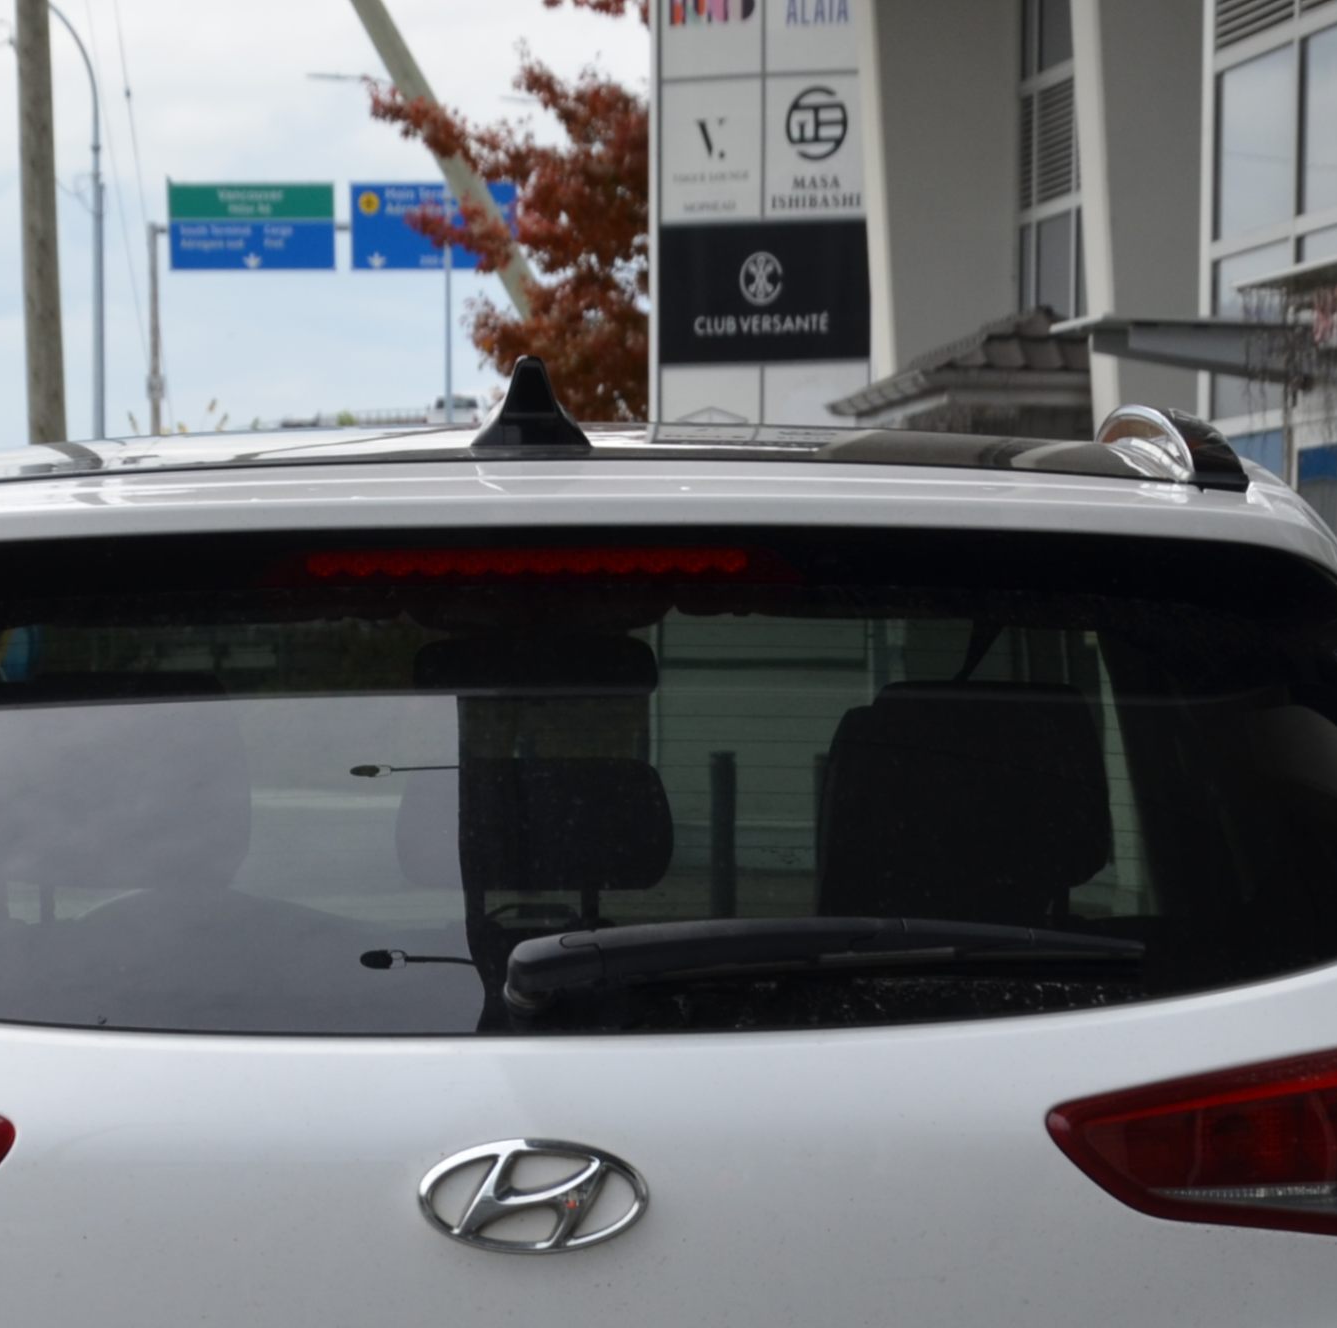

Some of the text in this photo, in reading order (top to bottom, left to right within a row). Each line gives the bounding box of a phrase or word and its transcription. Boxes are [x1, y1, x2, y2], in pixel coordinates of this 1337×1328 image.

[791, 174, 841, 190] MASA
[770, 192, 862, 209] ISHIBASHI
[693, 310, 829, 336] CLUB VERSANTÉ
